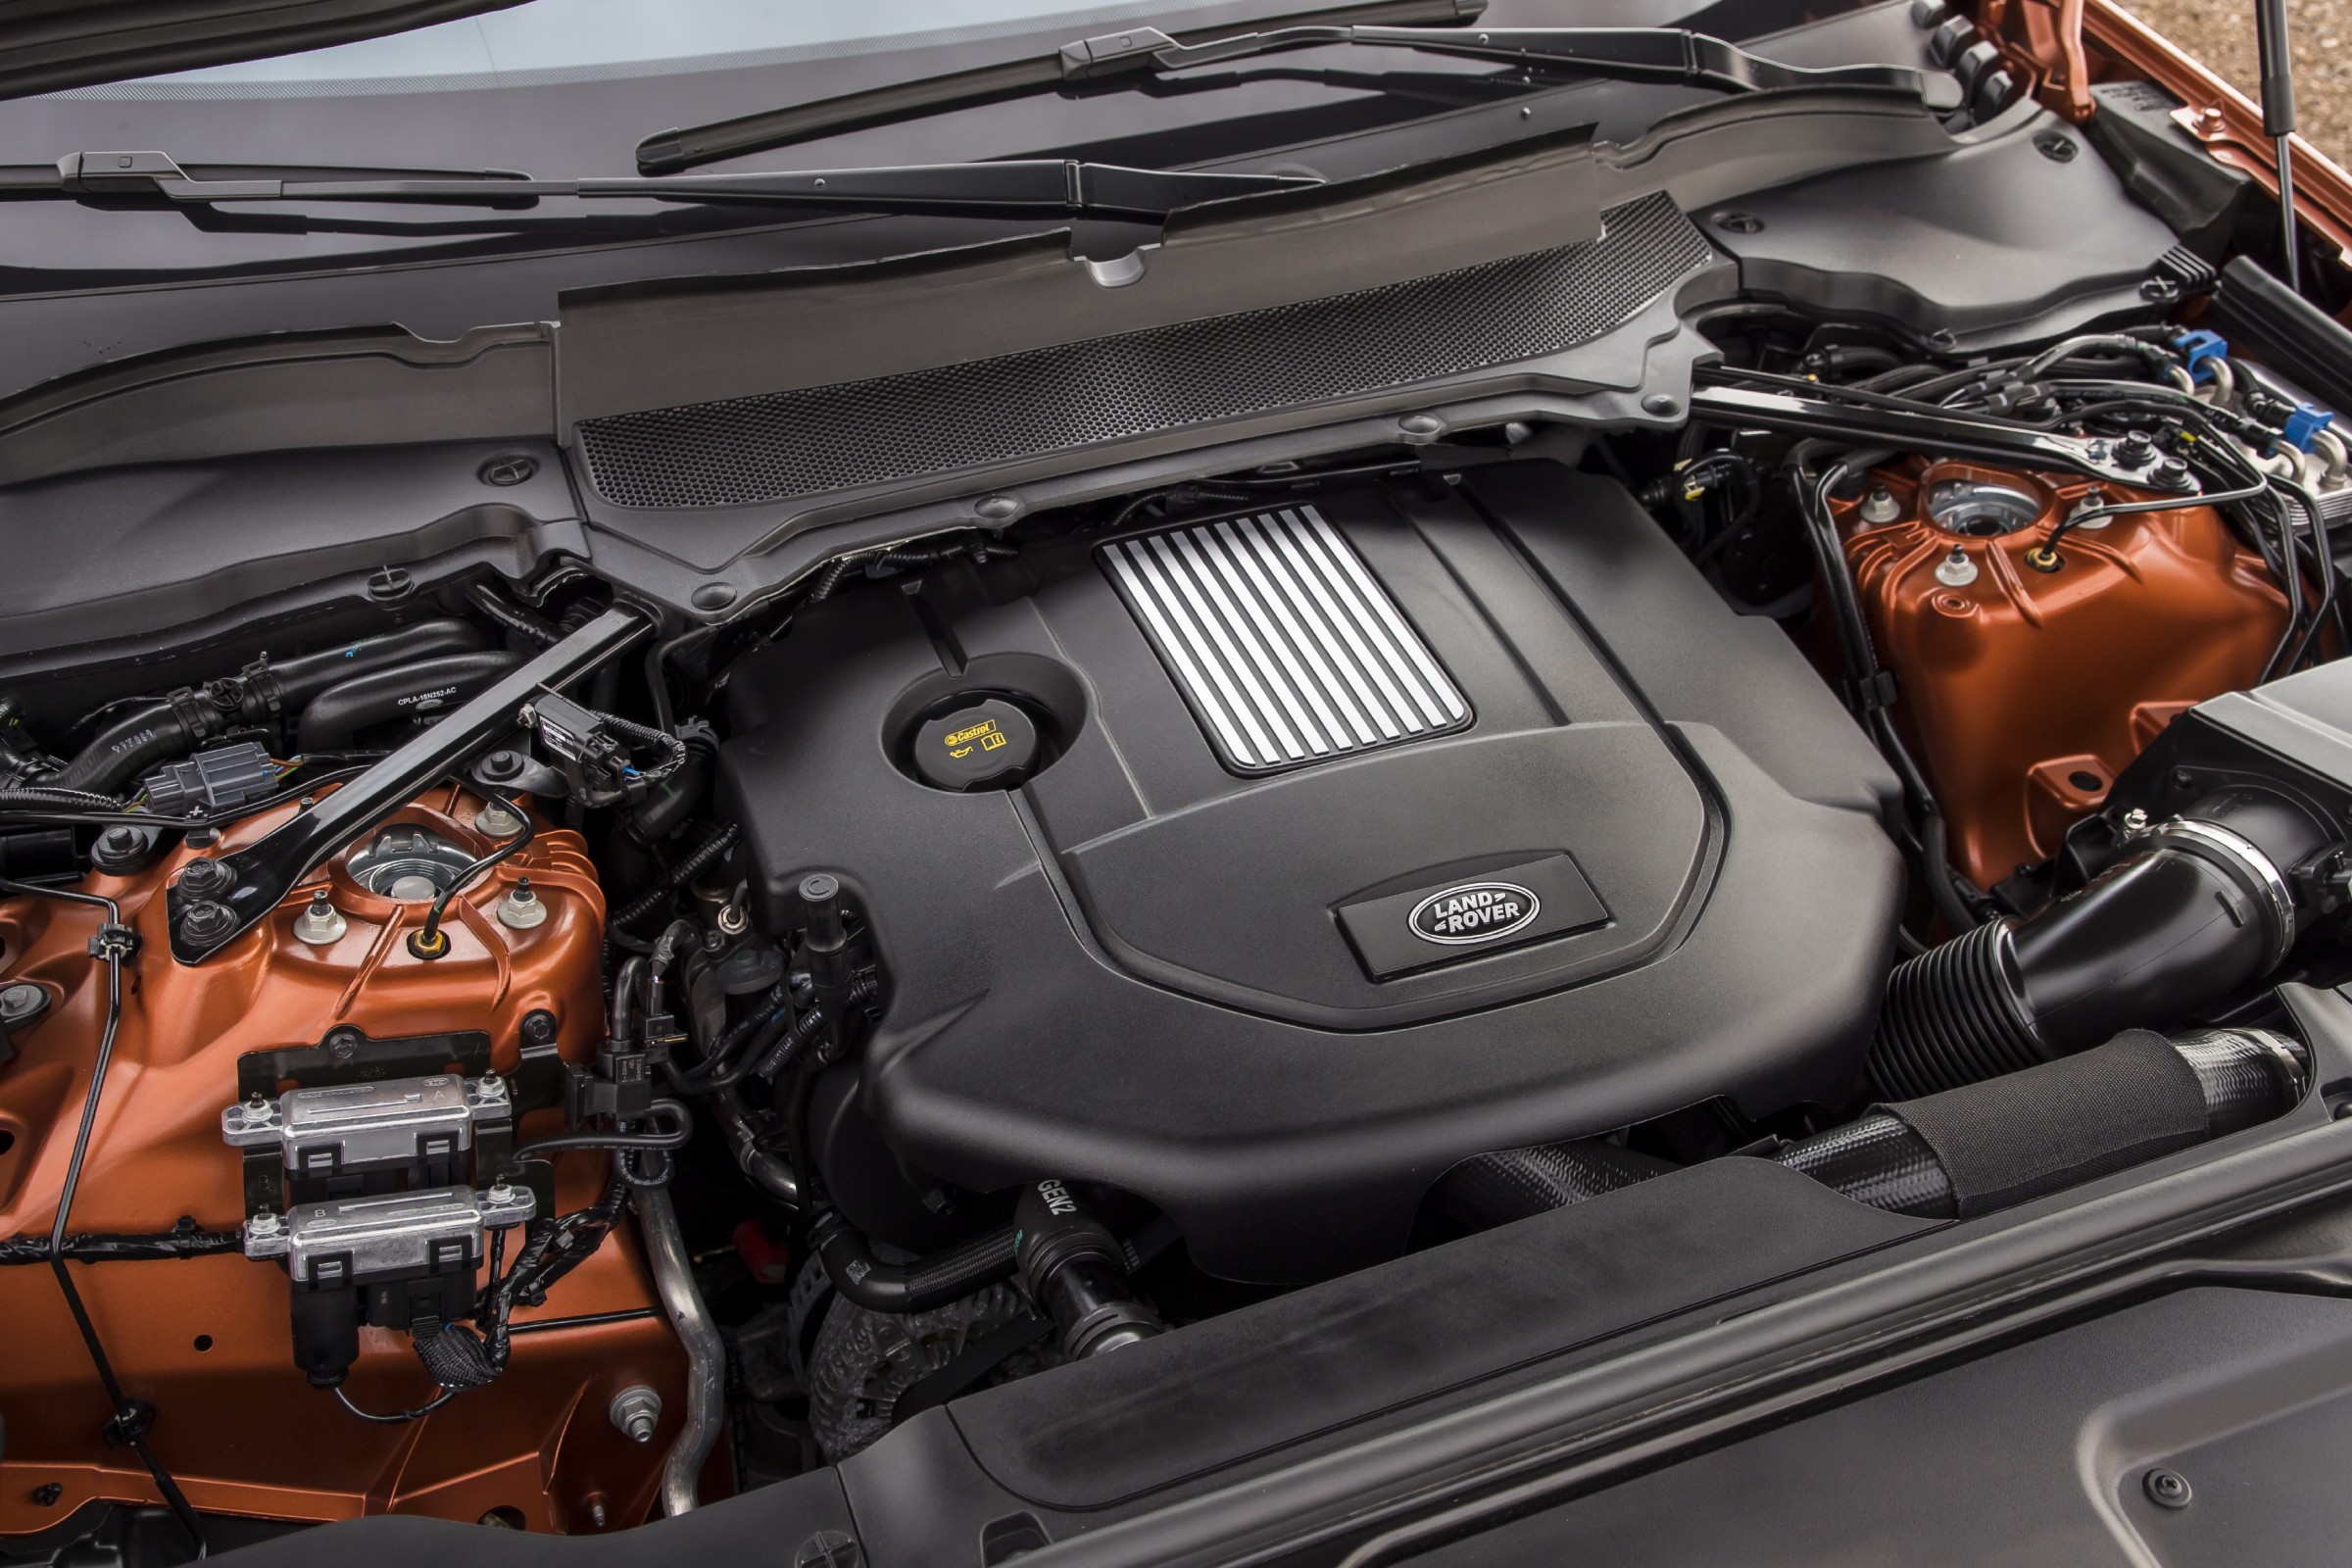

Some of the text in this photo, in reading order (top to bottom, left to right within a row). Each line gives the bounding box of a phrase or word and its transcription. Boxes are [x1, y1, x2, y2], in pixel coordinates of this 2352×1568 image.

[956, 722, 991, 742] Castrol
[1434, 891, 1494, 919] LAND
[1447, 902, 1521, 933] ROVER
[433, 1090, 446, 1101] A
[1037, 1179, 1077, 1215] GEN2
[314, 1208, 327, 1218] B
